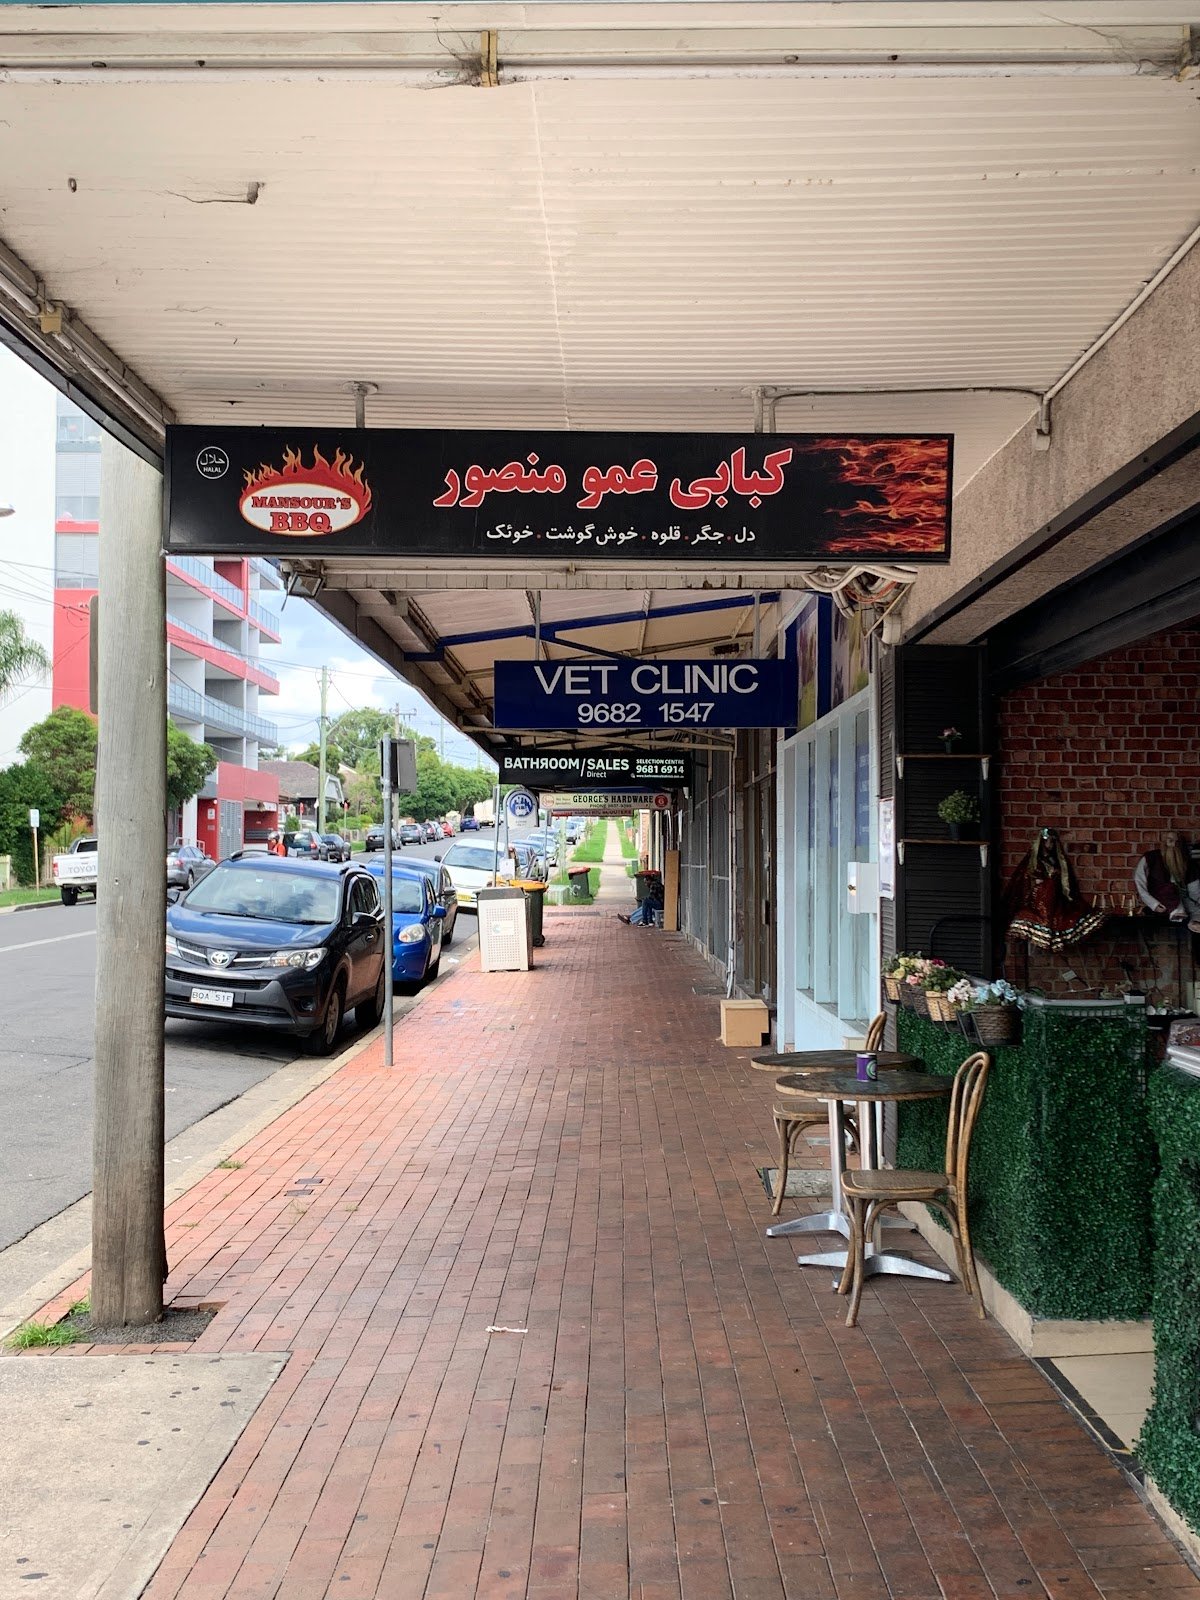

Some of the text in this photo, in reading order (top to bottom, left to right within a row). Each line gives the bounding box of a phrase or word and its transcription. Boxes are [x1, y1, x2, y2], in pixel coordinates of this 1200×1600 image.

[200, 453, 226, 466] حلال
[432, 447, 793, 510] کبابی عمو منصور
[251, 496, 351, 509] MANSOUR'S
[270, 512, 332, 533] BBQ
[651, 526, 681, 545] قلوه
[691, 526, 725, 546] جگر
[734, 526, 756, 543] دل
[534, 664, 760, 695] VET CLINIC
[577, 703, 715, 723] 9682 1547
[635, 765, 685, 774] 9681 6914
[572, 795, 609, 804] GEORGE'S
[611, 795, 654, 804] HARDWARE
